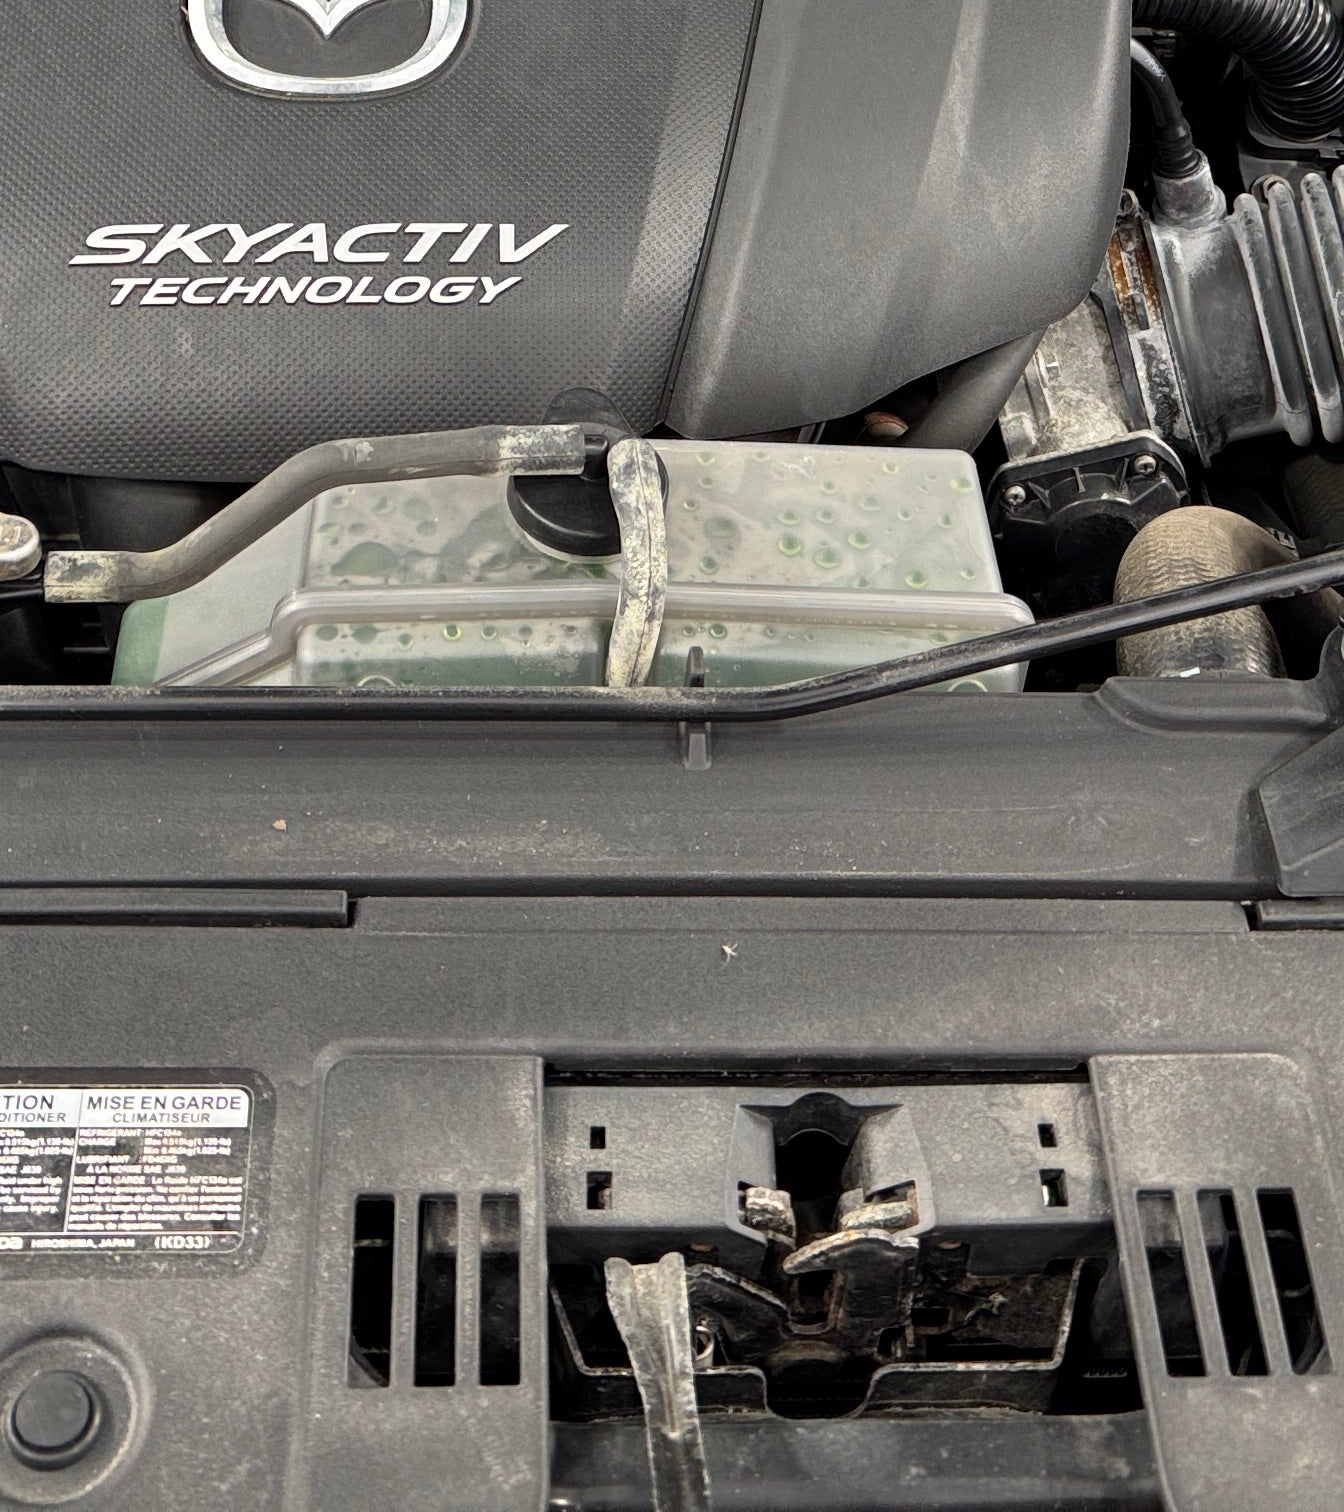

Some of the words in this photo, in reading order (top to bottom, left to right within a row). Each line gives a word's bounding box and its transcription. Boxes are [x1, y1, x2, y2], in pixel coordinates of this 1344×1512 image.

[68, 222, 570, 266] SKYACTIV
[109, 276, 523, 307] TECHNOLOGY
[86, 1095, 135, 1110] MISE
[140, 1095, 169, 1110] EN
[171, 1095, 242, 1110] GARDE
[112, 1112, 211, 1124] CLIMATISEUR
[98, 1239, 136, 1249] JAPAN
[154, 1235, 210, 1250] (KD33)
